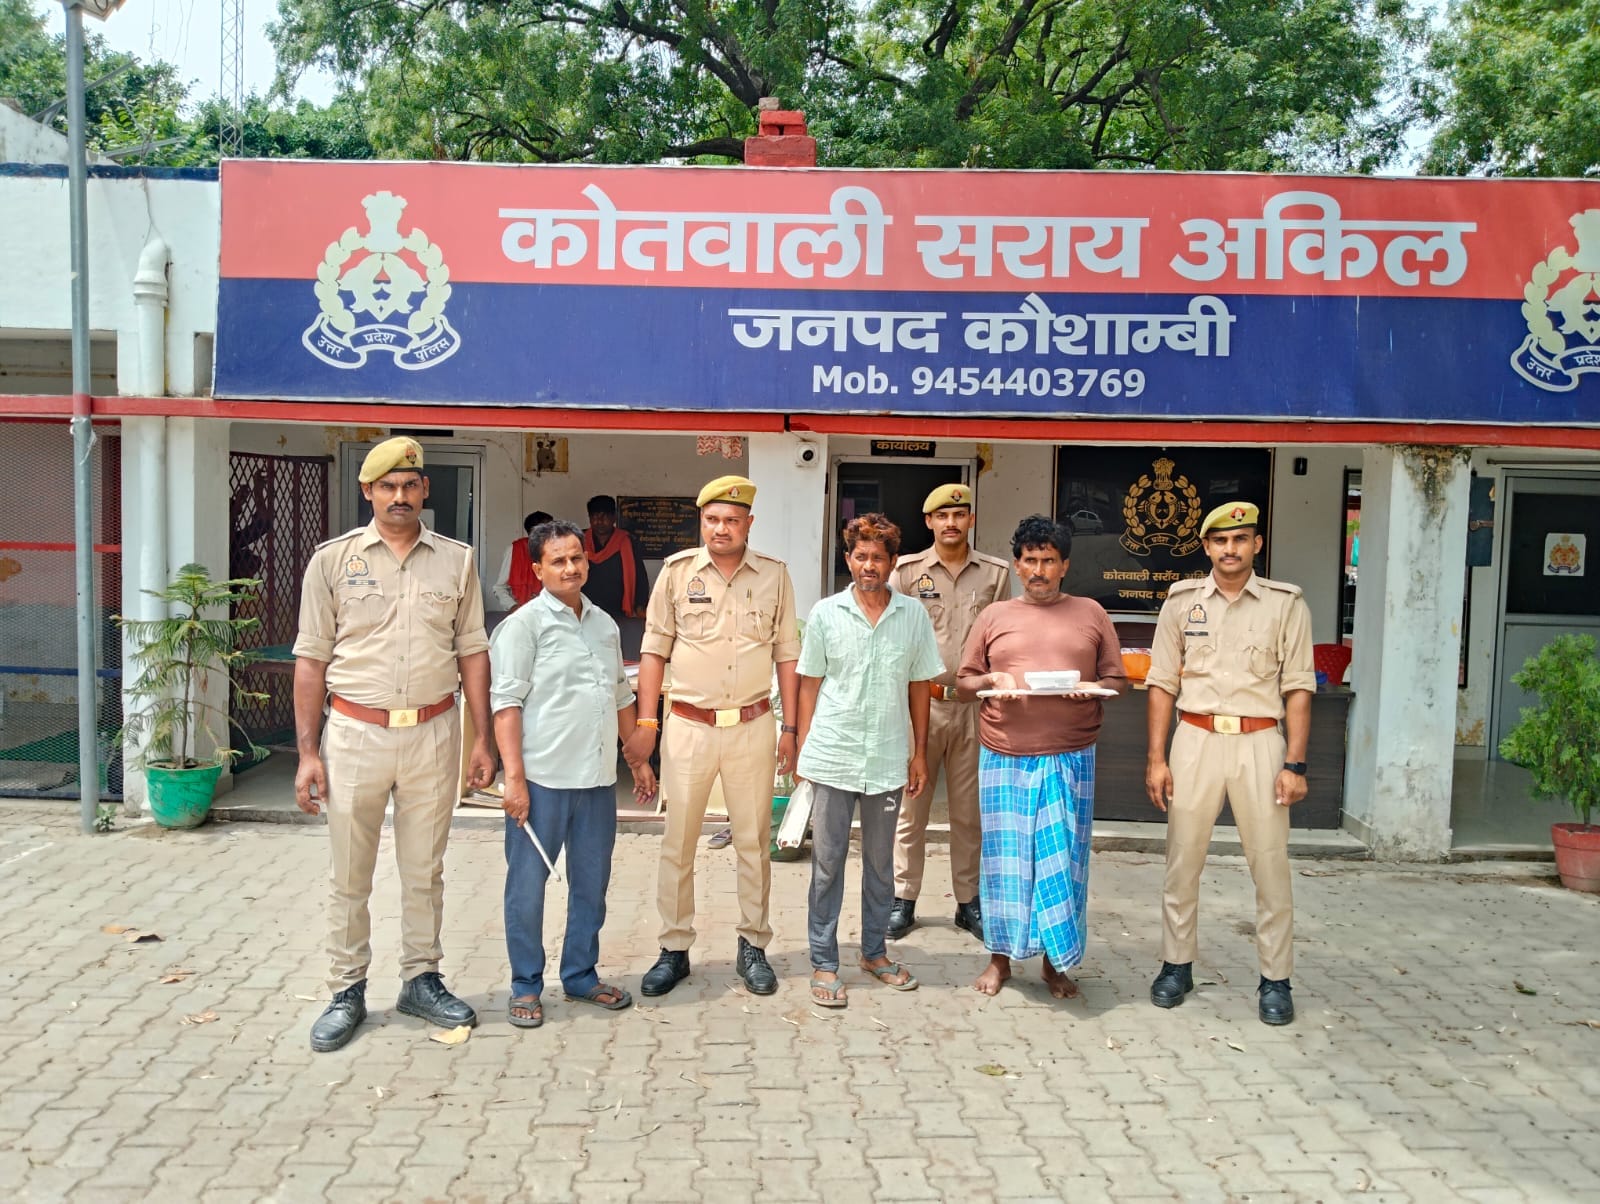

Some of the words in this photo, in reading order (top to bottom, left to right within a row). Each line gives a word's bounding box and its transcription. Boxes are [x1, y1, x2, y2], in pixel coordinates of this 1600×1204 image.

[497, 182, 894, 280] कोतवाली
[914, 214, 1150, 280] सराय
[1170, 190, 1477, 286] अकिल
[727, 308, 947, 353] जनपद
[962, 292, 1237, 357] कौशाम्बी
[317, 335, 345, 358] उत्तर
[362, 328, 397, 344] प्रदेश
[413, 337, 450, 363] पुलिस
[812, 365, 899, 394] Mob.
[911, 366, 1146, 397] 9454403769
[1526, 356, 1556, 380] उत्तर
[1103, 568, 1150, 581] कोतवाली
[1118, 589, 1154, 599] जनपद
